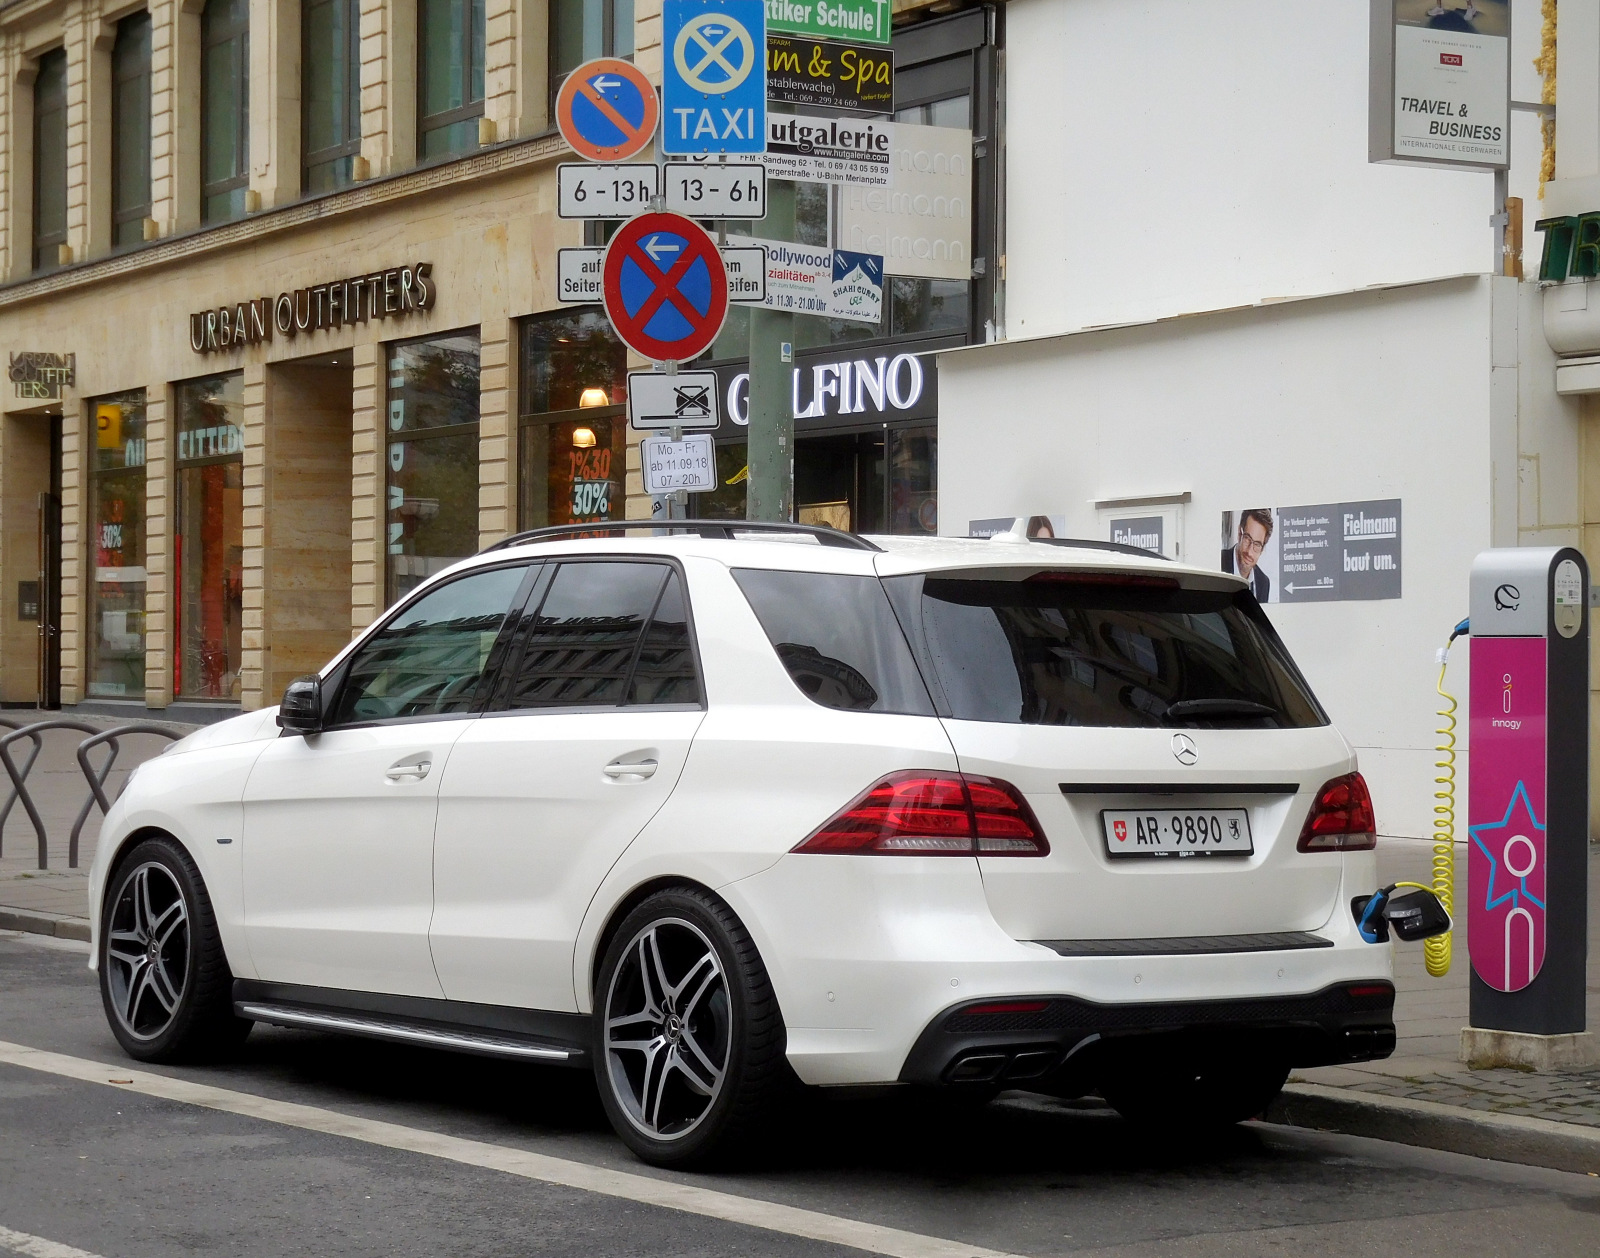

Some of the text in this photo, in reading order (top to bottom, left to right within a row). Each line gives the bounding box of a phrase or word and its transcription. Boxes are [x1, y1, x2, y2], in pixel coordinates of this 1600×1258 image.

[817, 2, 874, 32] Schule
[808, 45, 832, 77] &
[840, 50, 890, 94] Spa
[818, 96, 832, 104] 299
[833, 97, 843, 105] 24
[844, 99, 858, 107] 669
[1401, 97, 1468, 118] TRAVEL &
[673, 108, 754, 139] TAXI
[1429, 121, 1502, 142] BUSINESS
[767, 119, 888, 152] utgalerie
[813, 147, 888, 162] www.hutgalerie.com
[1400, 139, 1502, 156] INTERNATIONALE LEDERWAREN
[763, 155, 797, 167] Sandweg
[798, 159, 807, 167] 62
[814, 160, 827, 169] Tel.
[834, 162, 844, 171] 69
[848, 163, 858, 172] 43
[860, 164, 869, 173] 05
[869, 165, 879, 174] 59
[880, 166, 889, 175] 59
[767, 168, 811, 179] ergerstraße
[845, 174, 887, 186] Merianplatz
[574, 180, 587, 203] 6
[681, 179, 704, 202] 13
[581, 258, 602, 274] auf
[767, 268, 815, 283] zialitäten
[777, 294, 794, 308] 11.30
[832, 284, 880, 304] SHAHI CURRY
[190, 262, 436, 354] URBAN OUTFITTERS
[727, 352, 923, 427] GLFINO
[657, 444, 676, 455] Mo.
[685, 443, 698, 454] Fr.
[651, 457, 708, 471] ab 11.09.18
[661, 475, 673, 487] 07
[682, 474, 701, 485] 20h
[573, 482, 608, 516] 30%
[1344, 511, 1397, 536] Fielmann
[102, 524, 122, 549] 30%
[1113, 527, 1160, 549] Fielmann
[1344, 548, 1397, 572] baut um.
[1492, 717, 1521, 730] innogy
